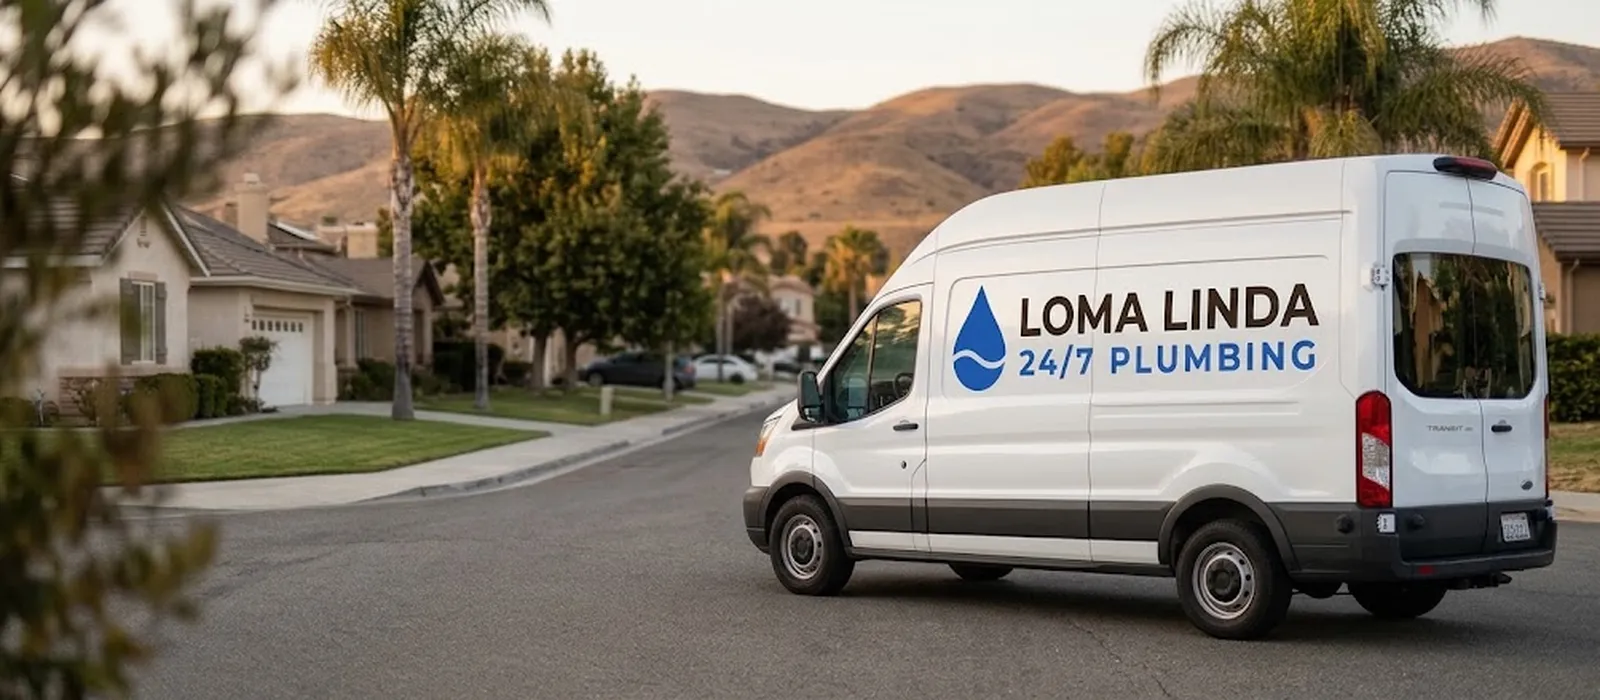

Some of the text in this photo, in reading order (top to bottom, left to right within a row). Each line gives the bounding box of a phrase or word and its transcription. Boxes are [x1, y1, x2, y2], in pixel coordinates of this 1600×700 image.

[1020, 283, 1319, 337] LOMA LINDA
[1019, 340, 1316, 379] 24/7 PLUMBING
